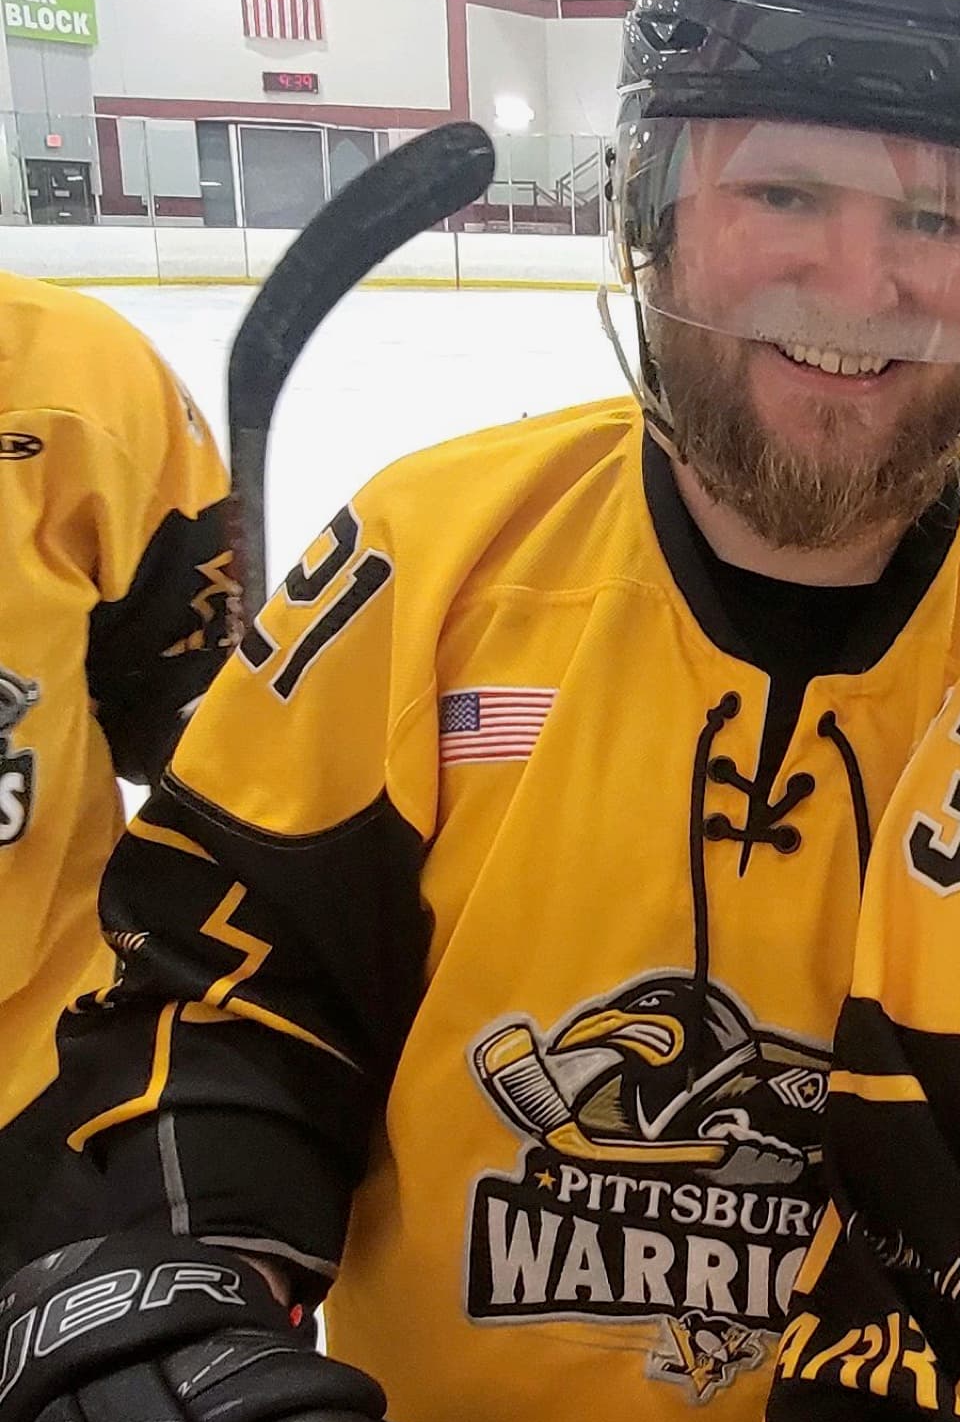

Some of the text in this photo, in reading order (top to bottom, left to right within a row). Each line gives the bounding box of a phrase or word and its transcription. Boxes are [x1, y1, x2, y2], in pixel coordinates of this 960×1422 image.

[4, 2, 91, 36] BLOCK
[235, 501, 395, 706] 21
[487, 1195, 807, 1319] WARRI
[556, 1164, 824, 1238] PITTSBUR
[0, 1262, 247, 1404] UER
